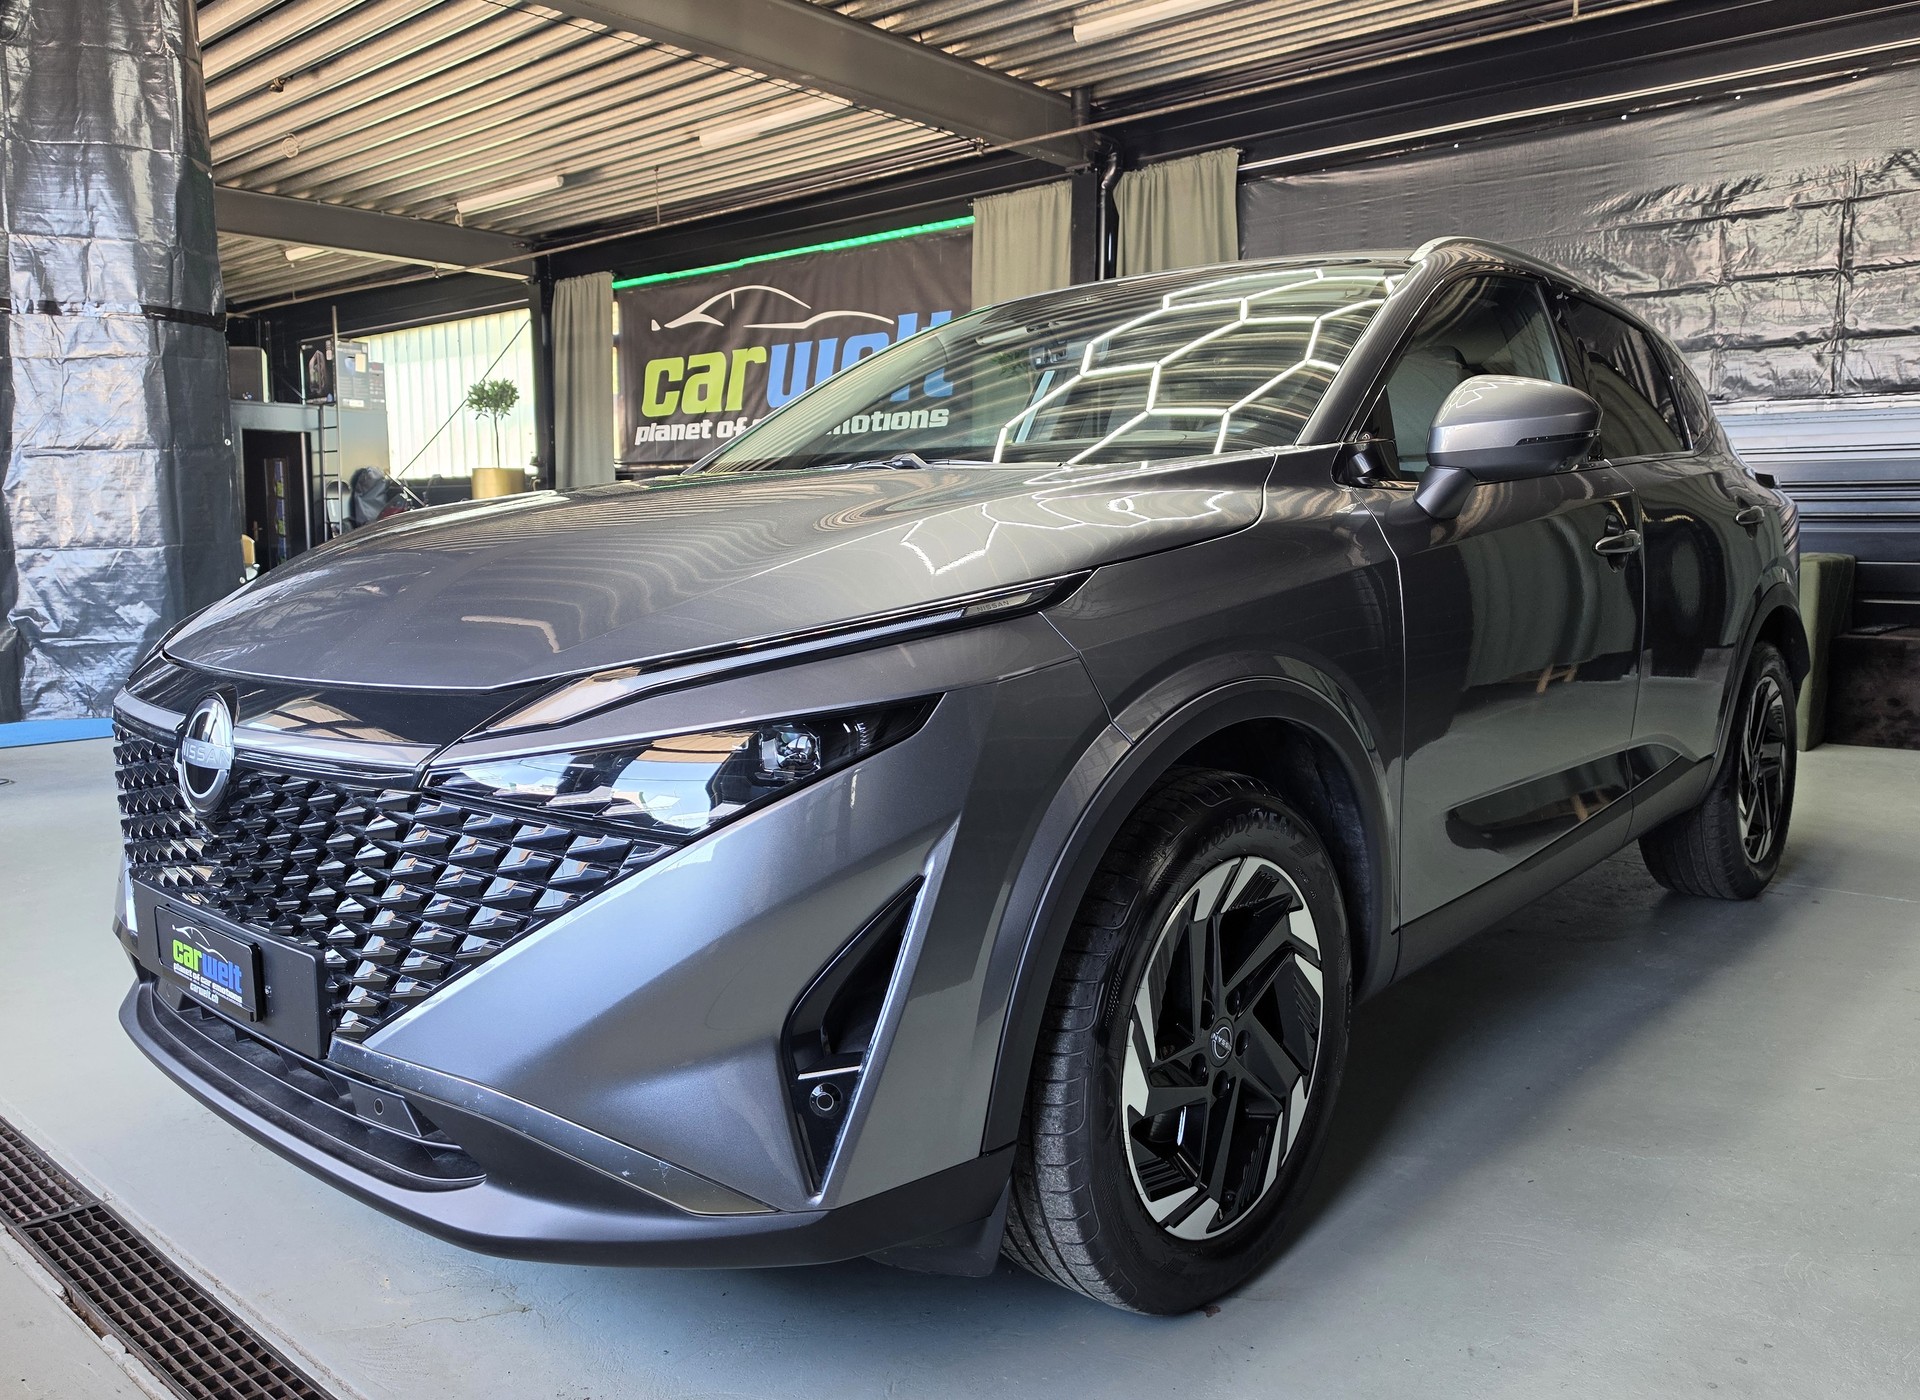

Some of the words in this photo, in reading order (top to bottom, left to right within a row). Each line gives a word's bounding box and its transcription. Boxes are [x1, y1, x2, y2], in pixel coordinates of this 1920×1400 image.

[635, 419, 713, 446] planet
[717, 416, 748, 438] of
[977, 600, 1010, 612] NISSAN
[182, 740, 231, 763] NISSAN
[173, 939, 242, 994] carwelt
